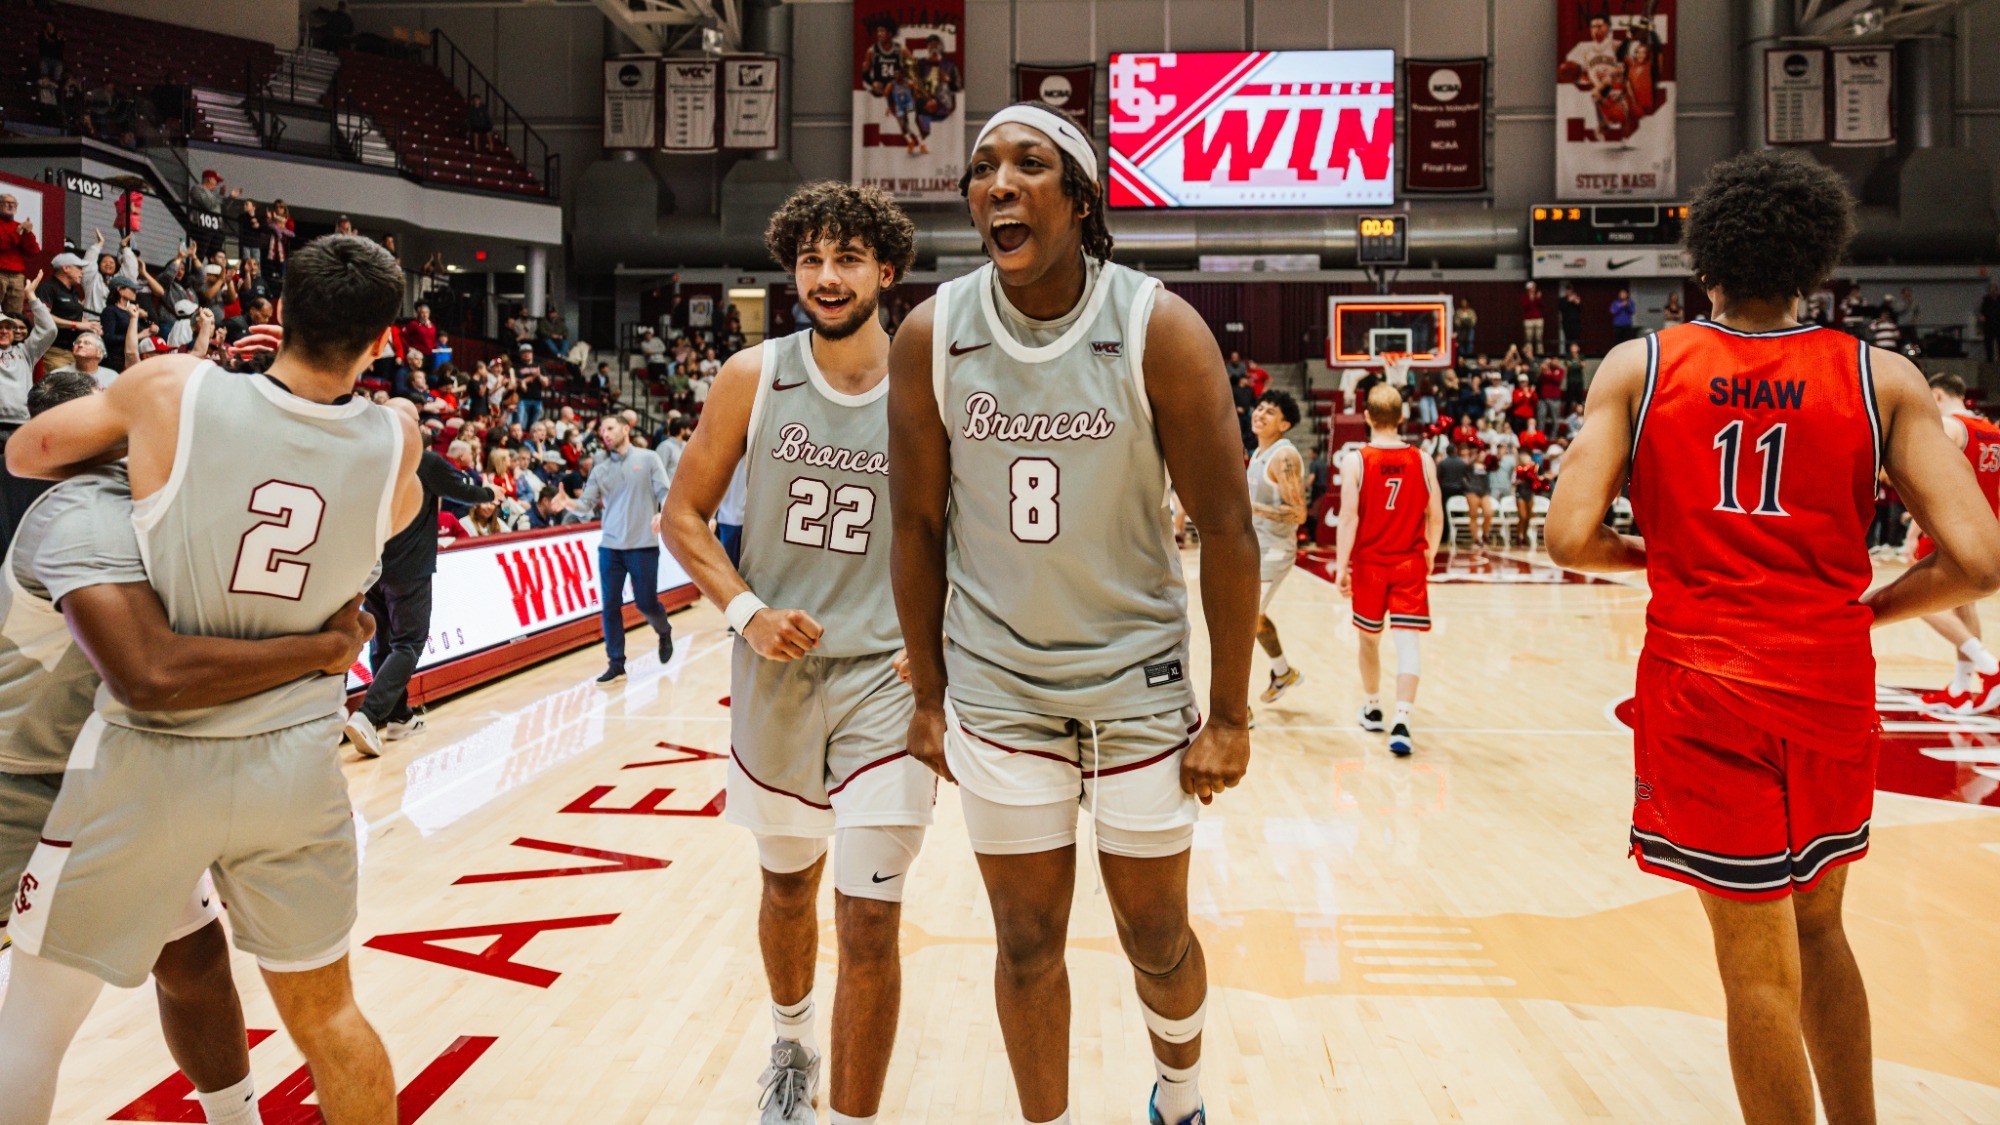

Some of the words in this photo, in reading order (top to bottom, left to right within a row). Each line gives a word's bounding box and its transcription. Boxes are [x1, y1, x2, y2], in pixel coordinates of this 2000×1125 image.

[1183, 107, 1394, 182] WIN
[1430, 141, 1459, 150] NCAA
[1422, 163, 1444, 172] Final
[1446, 163, 1468, 172] Four
[1576, 173, 1618, 188] STEVE
[1621, 173, 1656, 188] NASH
[77, 178, 101, 197] 102
[898, 178, 959, 192] WILLIAMS
[200, 213, 219, 230] 103
[1091, 342, 1121, 354] WCC
[1709, 377, 1805, 411] SHAW
[961, 391, 1115, 443] Broncos
[1381, 464, 1407, 475] DENT
[1713, 420, 1791, 517] 11
[1979, 442, 2000, 472] 23
[1009, 456, 1061, 544] 8
[1384, 478, 1402, 510] 7
[783, 476, 876, 555] 22
[228, 478, 326, 602] 2
[495, 539, 599, 628] WIN!
[1170, 666, 1179, 676] XL
